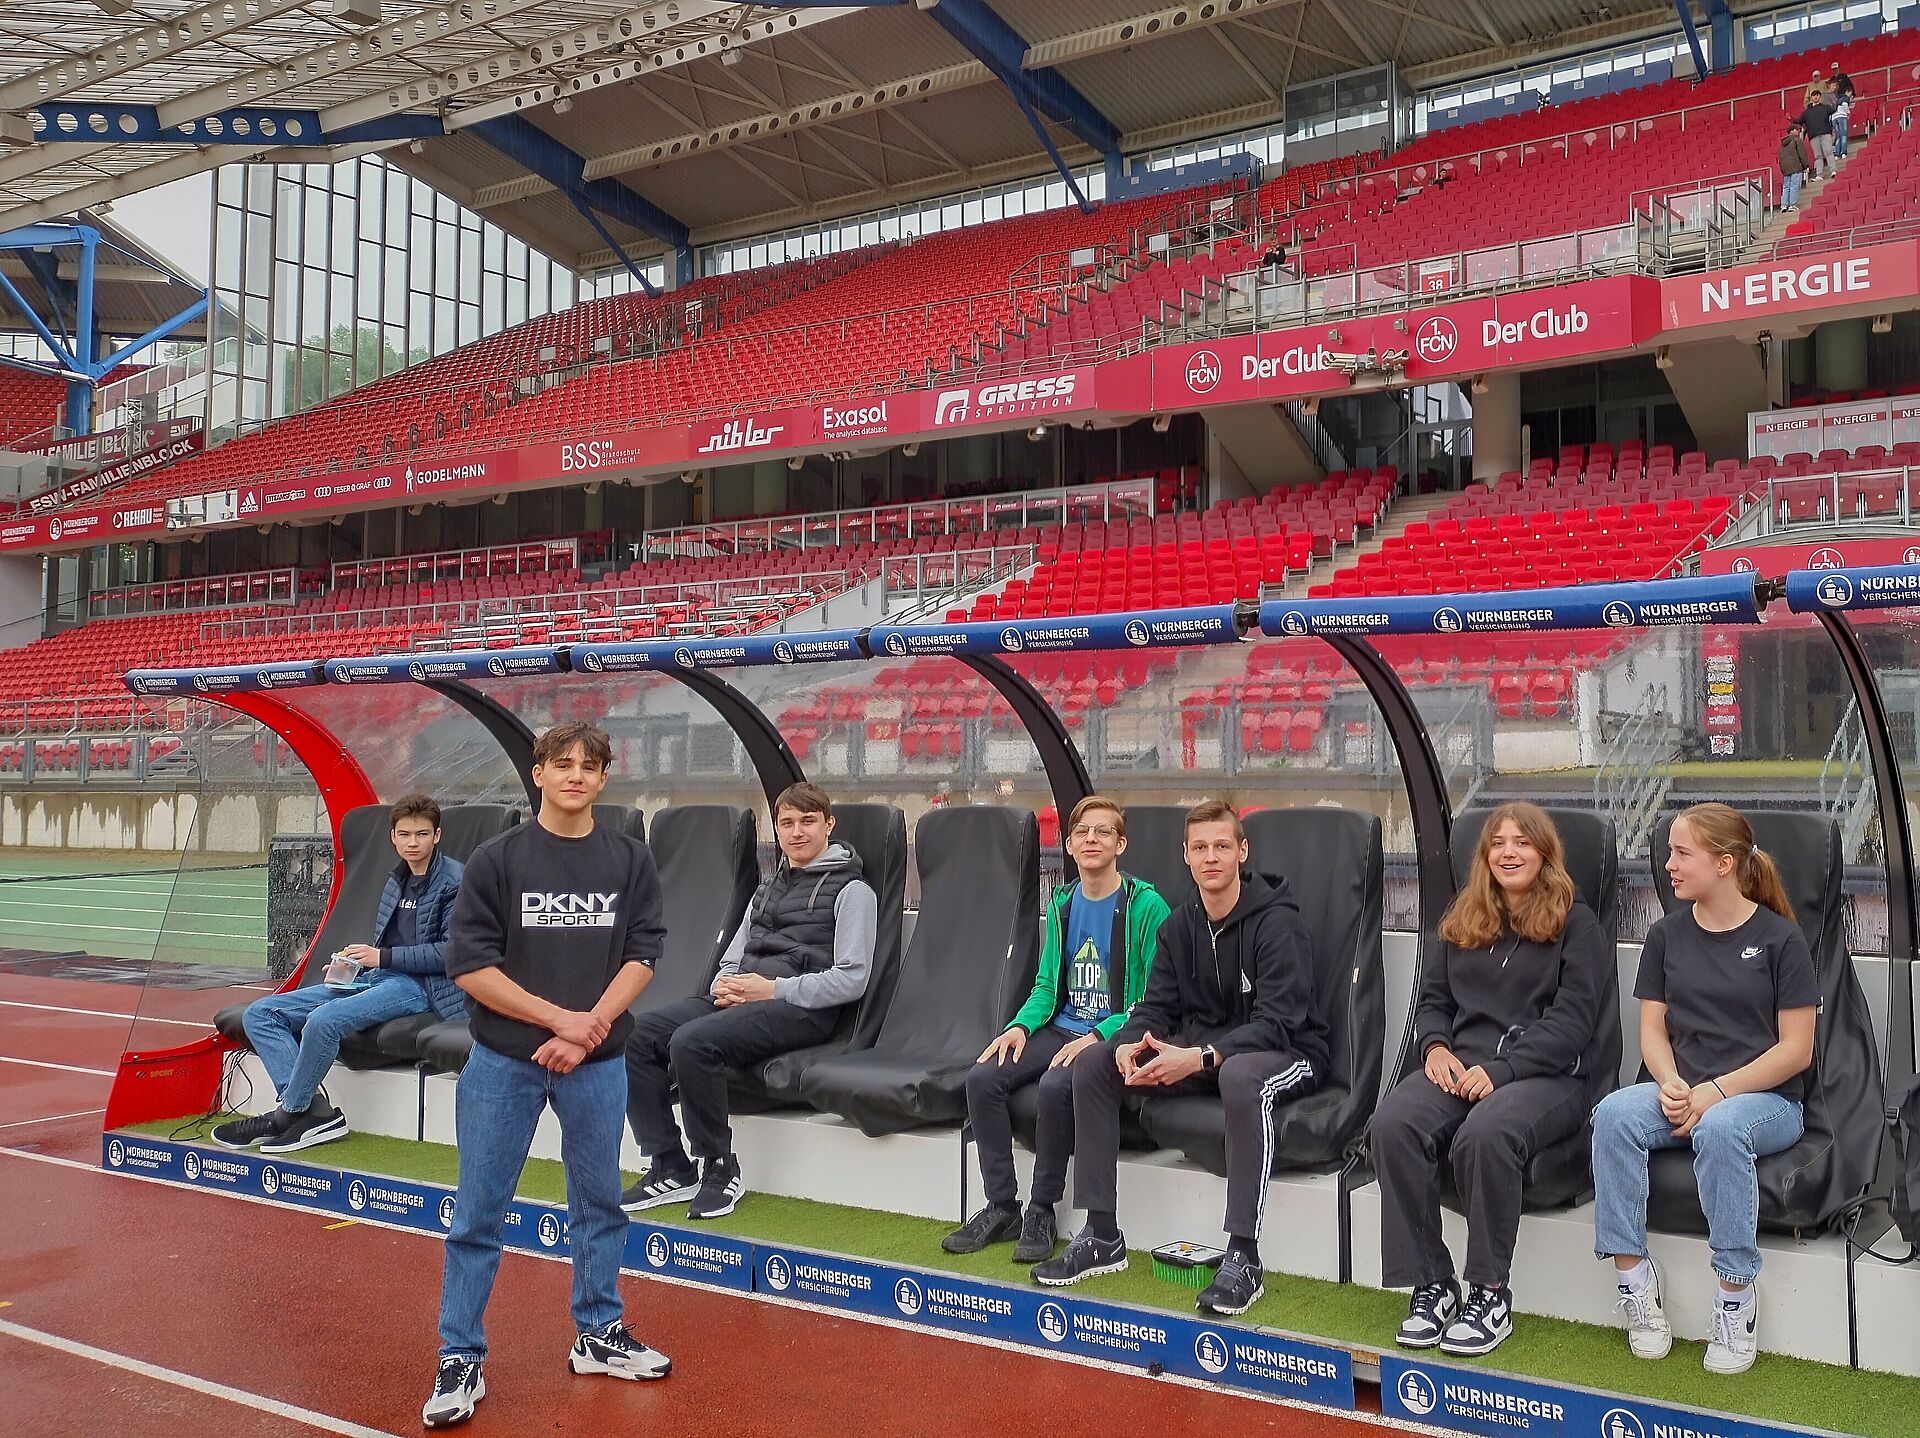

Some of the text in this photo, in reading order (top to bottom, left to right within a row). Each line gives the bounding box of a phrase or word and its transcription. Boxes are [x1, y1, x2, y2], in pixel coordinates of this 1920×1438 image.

[1482, 304, 1589, 347] Der Club
[1420, 332, 1453, 354] FCN
[1241, 343, 1331, 381] Der Club
[1189, 366, 1217, 385] FCN
[978, 374, 1076, 406] GRESS
[823, 400, 888, 430] Exasol
[975, 395, 1073, 418] SPEDITION
[823, 425, 888, 440] The analytics database
[29, 438, 194, 513] ESW-FAMILIENBLOCK
[417, 463, 485, 485] GODELMANN
[334, 481, 371, 494] FESER GRAF
[123, 508, 153, 527] REHAU
[240, 504, 258, 513] adidas
[1860, 575, 1920, 591] NÜRNB
[1467, 608, 1553, 623] NÜRNBERGER
[1640, 599, 1738, 617] NÜRNBERGER
[1152, 617, 1222, 633] NÜRNBERGER
[1311, 613, 1389, 627] NÜRNBERGER
[1469, 621, 1531, 631] VERSICHERUNG
[1642, 613, 1712, 625] VERSICHERUNG
[1025, 627, 1090, 641] NÜRNBERGER
[1154, 631, 1205, 642] VERSICHERUNG
[1313, 625, 1370, 634] VERSICHERUNG
[794, 640, 850, 653] NÜRNBERGER
[907, 633, 968, 646] NÜRNBERGER
[1027, 639, 1074, 648] VERSICHERUNG
[505, 656, 550, 669] NÜRNBERGER
[601, 652, 650, 663] NÜRNBERGER
[694, 647, 746, 660] NÜRNBERGER
[271, 670, 306, 681] NÜRNBERGER
[349, 666, 389, 676] NÜRNBERGER
[425, 662, 466, 673] NÜRNBERGER
[206, 675, 240, 685] NÜRNBERGER
[521, 892, 618, 913] DKNY
[536, 914, 602, 925] SPORT
[1074, 962, 1101, 989] TOP
[1068, 991, 1111, 1010] THE WOR
[150, 1068, 173, 1078] SPORT
[126, 1145, 172, 1163] NÜRNBERGER
[202, 1158, 250, 1177] NÜRNBERGER
[203, 1170, 237, 1183] VERSICHERUNG
[281, 1172, 332, 1192] NÜRNBERGER
[282, 1185, 317, 1199] VERSICHERUNG
[369, 1187, 424, 1208] NÜRNBERGER
[369, 1200, 408, 1216] VERSICHERUNG
[673, 1241, 743, 1267] NÜRNBERGER
[674, 1256, 723, 1274] VERSICHERUNG
[795, 1263, 872, 1291] NÜRNBERGER
[796, 1279, 850, 1298] VERSICHERUNG
[926, 1287, 1012, 1316] NÜRNBERGER
[928, 1303, 988, 1324] VERSICHERUNG
[1073, 1312, 1168, 1345] NÜRNBERGER
[1074, 1330, 1141, 1352] VERSICHERUNG
[1234, 1343, 1338, 1380] NÜRNBERGER
[1236, 1362, 1308, 1387] VERSICHERUNG
[1443, 1382, 1564, 1421] NÜRNBERGER
[1444, 1401, 1530, 1429] VERSICHERUNG
